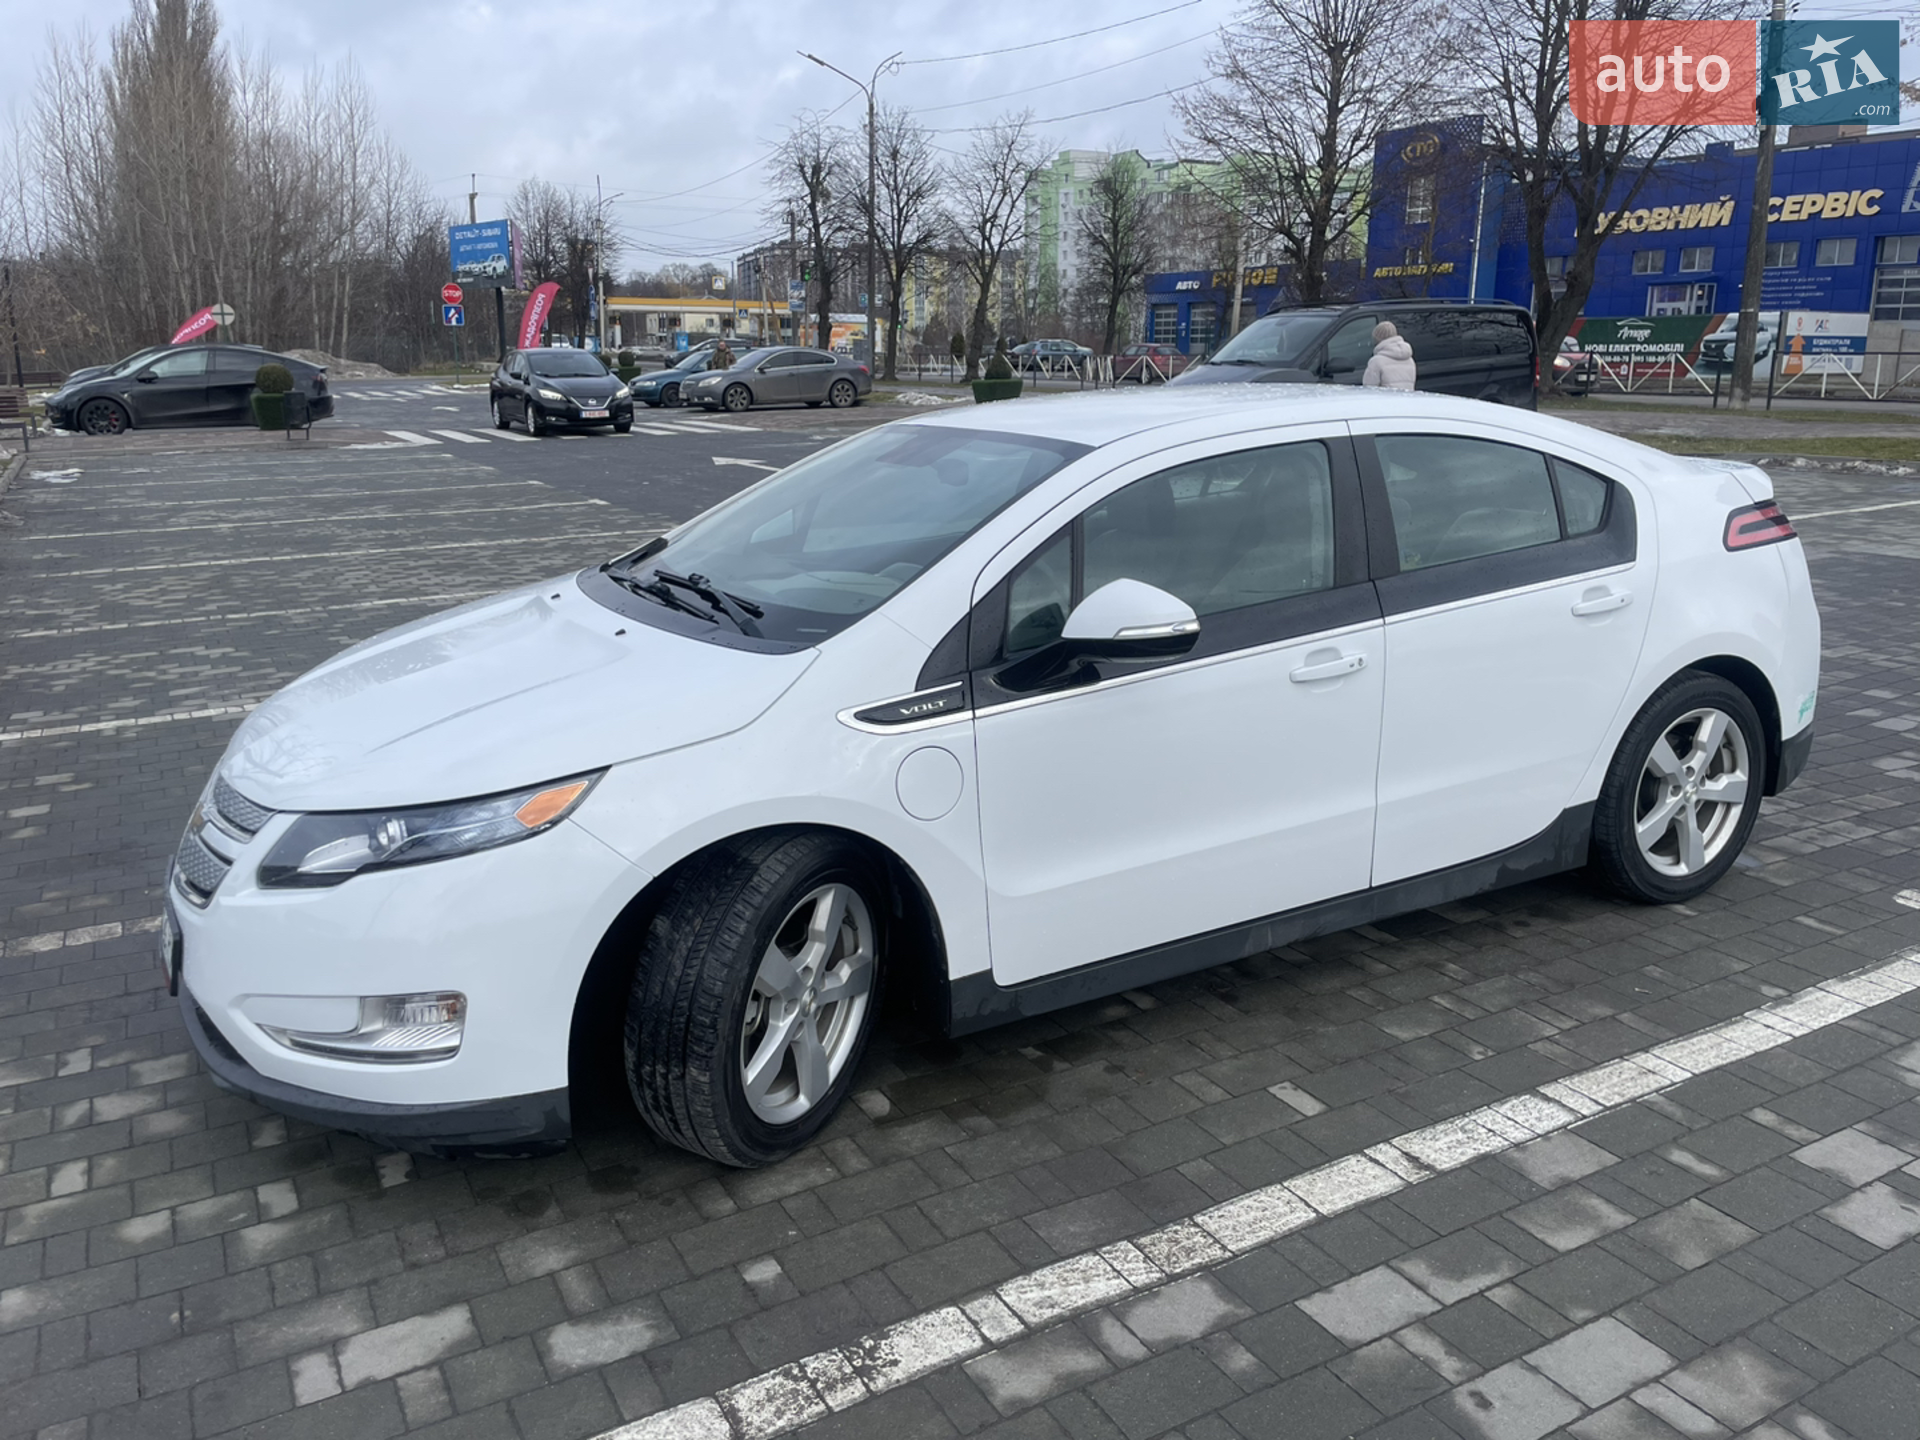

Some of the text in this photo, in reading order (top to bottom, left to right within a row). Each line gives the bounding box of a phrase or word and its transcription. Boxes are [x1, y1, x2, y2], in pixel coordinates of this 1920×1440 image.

[1574, 188, 1885, 237] УЗОВНИЙ СЕРВІС
[1373, 262, 1454, 278] АВТОМАГЗИН
[1584, 343, 1684, 352] НОВІ ЕЛЕКТРОМОБІЛІ
[899, 699, 948, 715] VOLT
